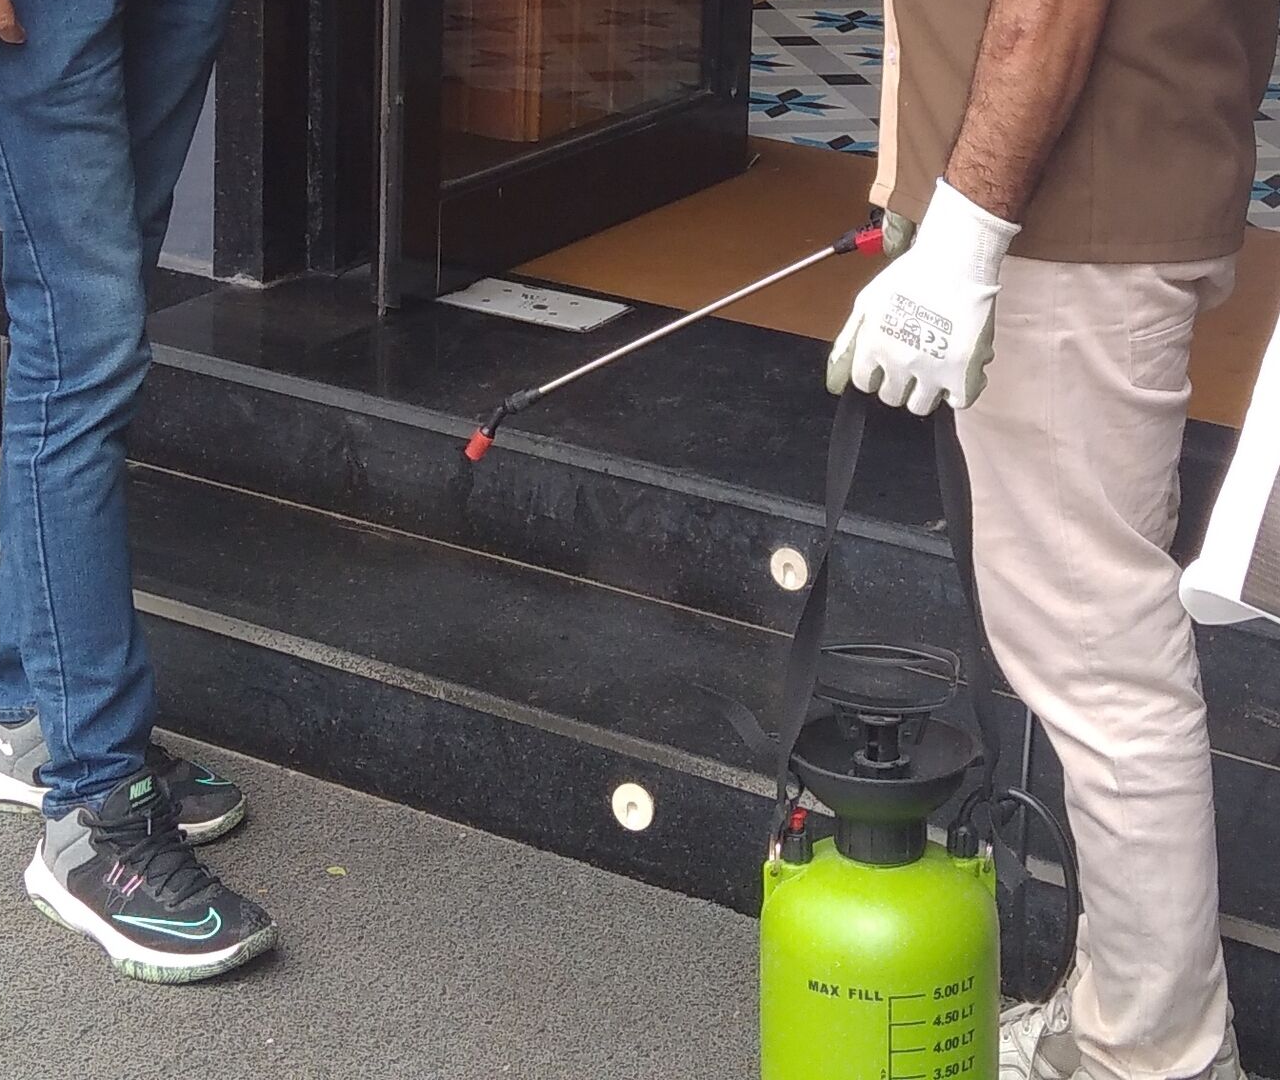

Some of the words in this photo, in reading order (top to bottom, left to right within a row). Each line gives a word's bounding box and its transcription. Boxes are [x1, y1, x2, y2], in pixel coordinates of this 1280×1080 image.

[129, 775, 153, 800] NIKE
[807, 979, 840, 998] MAX
[848, 987, 884, 1002] FILL
[932, 982, 959, 1000] 5.00
[961, 976, 976, 993] LT
[931, 1009, 959, 1027] 4.50
[961, 1002, 976, 1020] LT
[932, 1035, 960, 1053] 4.00
[961, 1028, 976, 1046] LT
[932, 1062, 960, 1080] 3.50
[961, 1055, 976, 1073] LT
